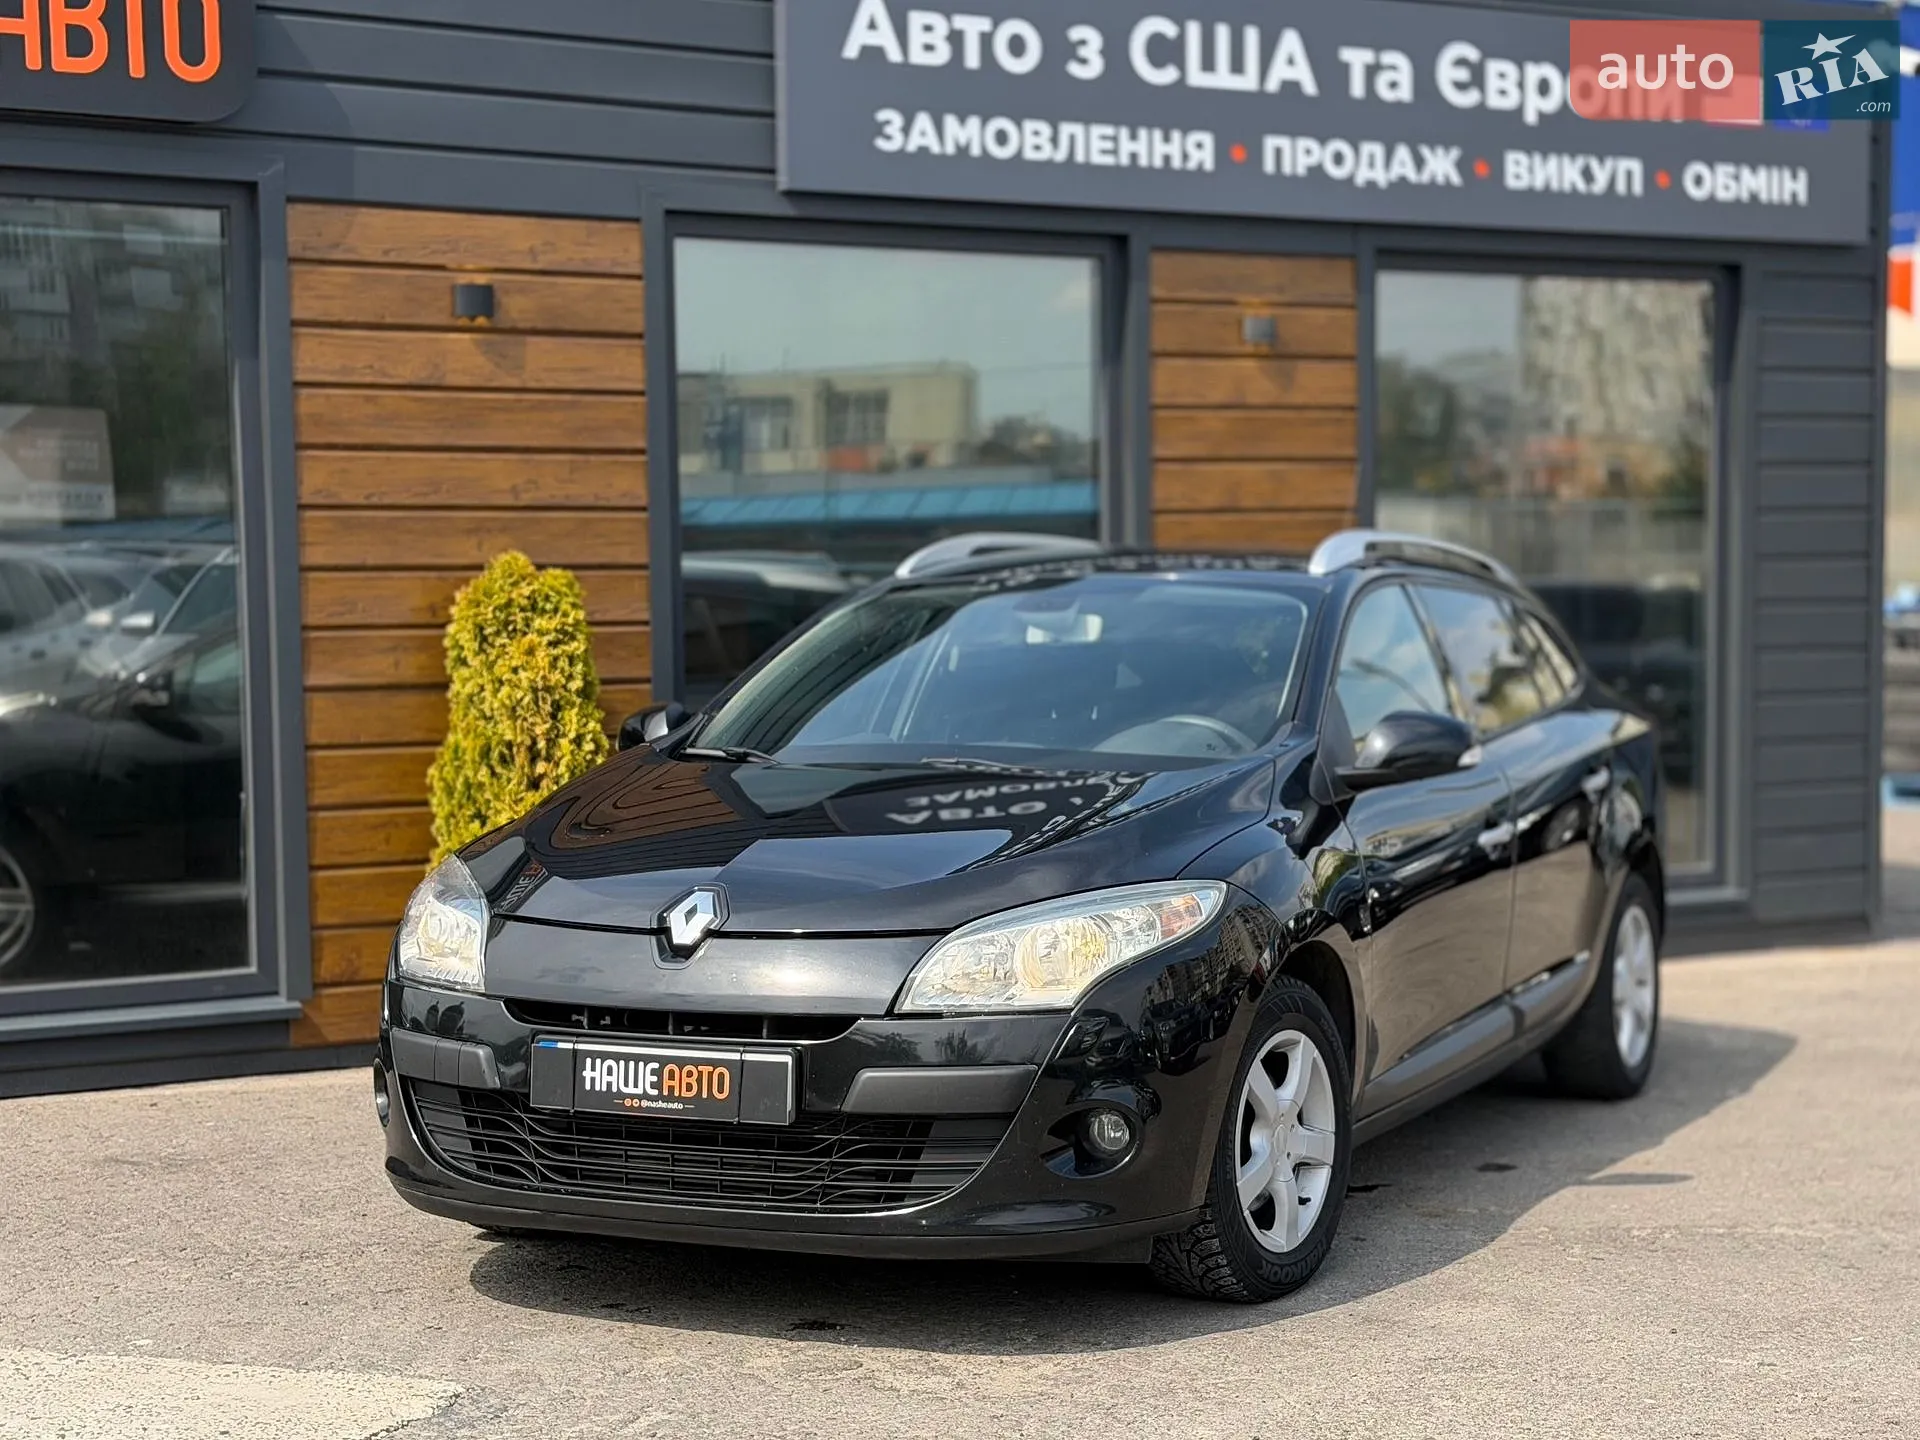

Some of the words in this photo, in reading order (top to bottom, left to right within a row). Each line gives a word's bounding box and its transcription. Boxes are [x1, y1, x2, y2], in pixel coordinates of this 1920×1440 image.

[841, 0, 1043, 75] Авто
[1065, 24, 1105, 81] з
[1128, 15, 1319, 97] США
[1338, 44, 1414, 103] та
[873, 108, 1216, 173] ЗАМОВЛЕННЯ
[1262, 134, 1463, 189] ПРОДАЖ
[1503, 150, 1644, 197] ВИКУП
[1682, 161, 1809, 207] ОБМІН
